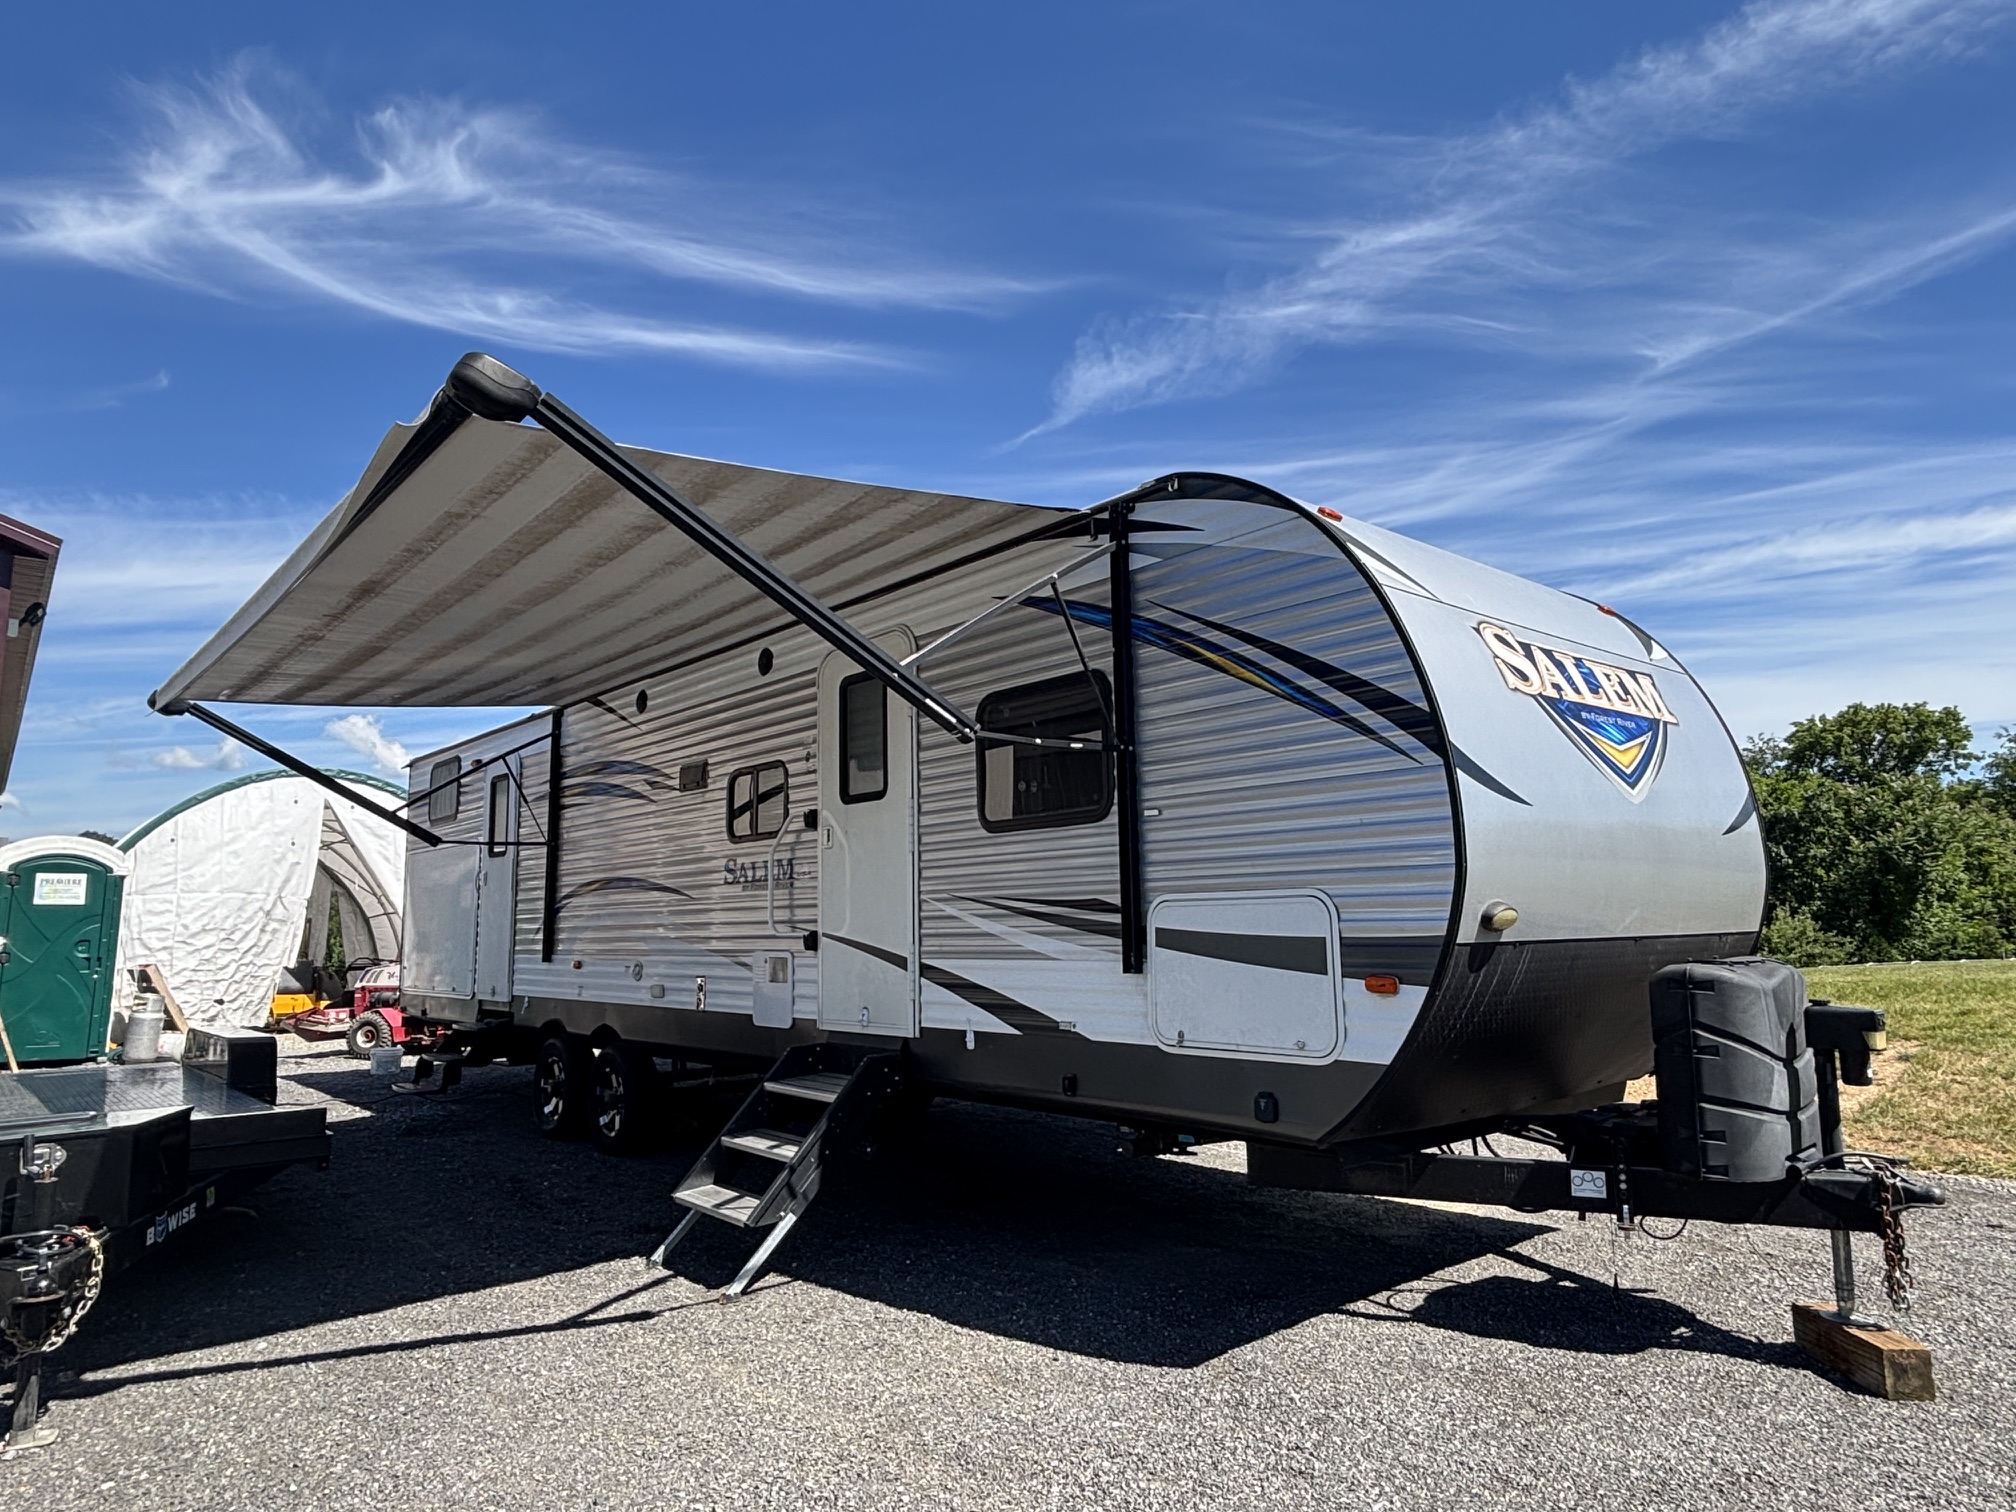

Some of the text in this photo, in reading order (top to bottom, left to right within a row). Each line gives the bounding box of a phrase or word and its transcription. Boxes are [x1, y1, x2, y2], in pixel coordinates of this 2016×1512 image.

[1479, 622, 1679, 725] SALEM
[1590, 712, 1617, 725] FOREST
[1616, 717, 1637, 729] RIVER
